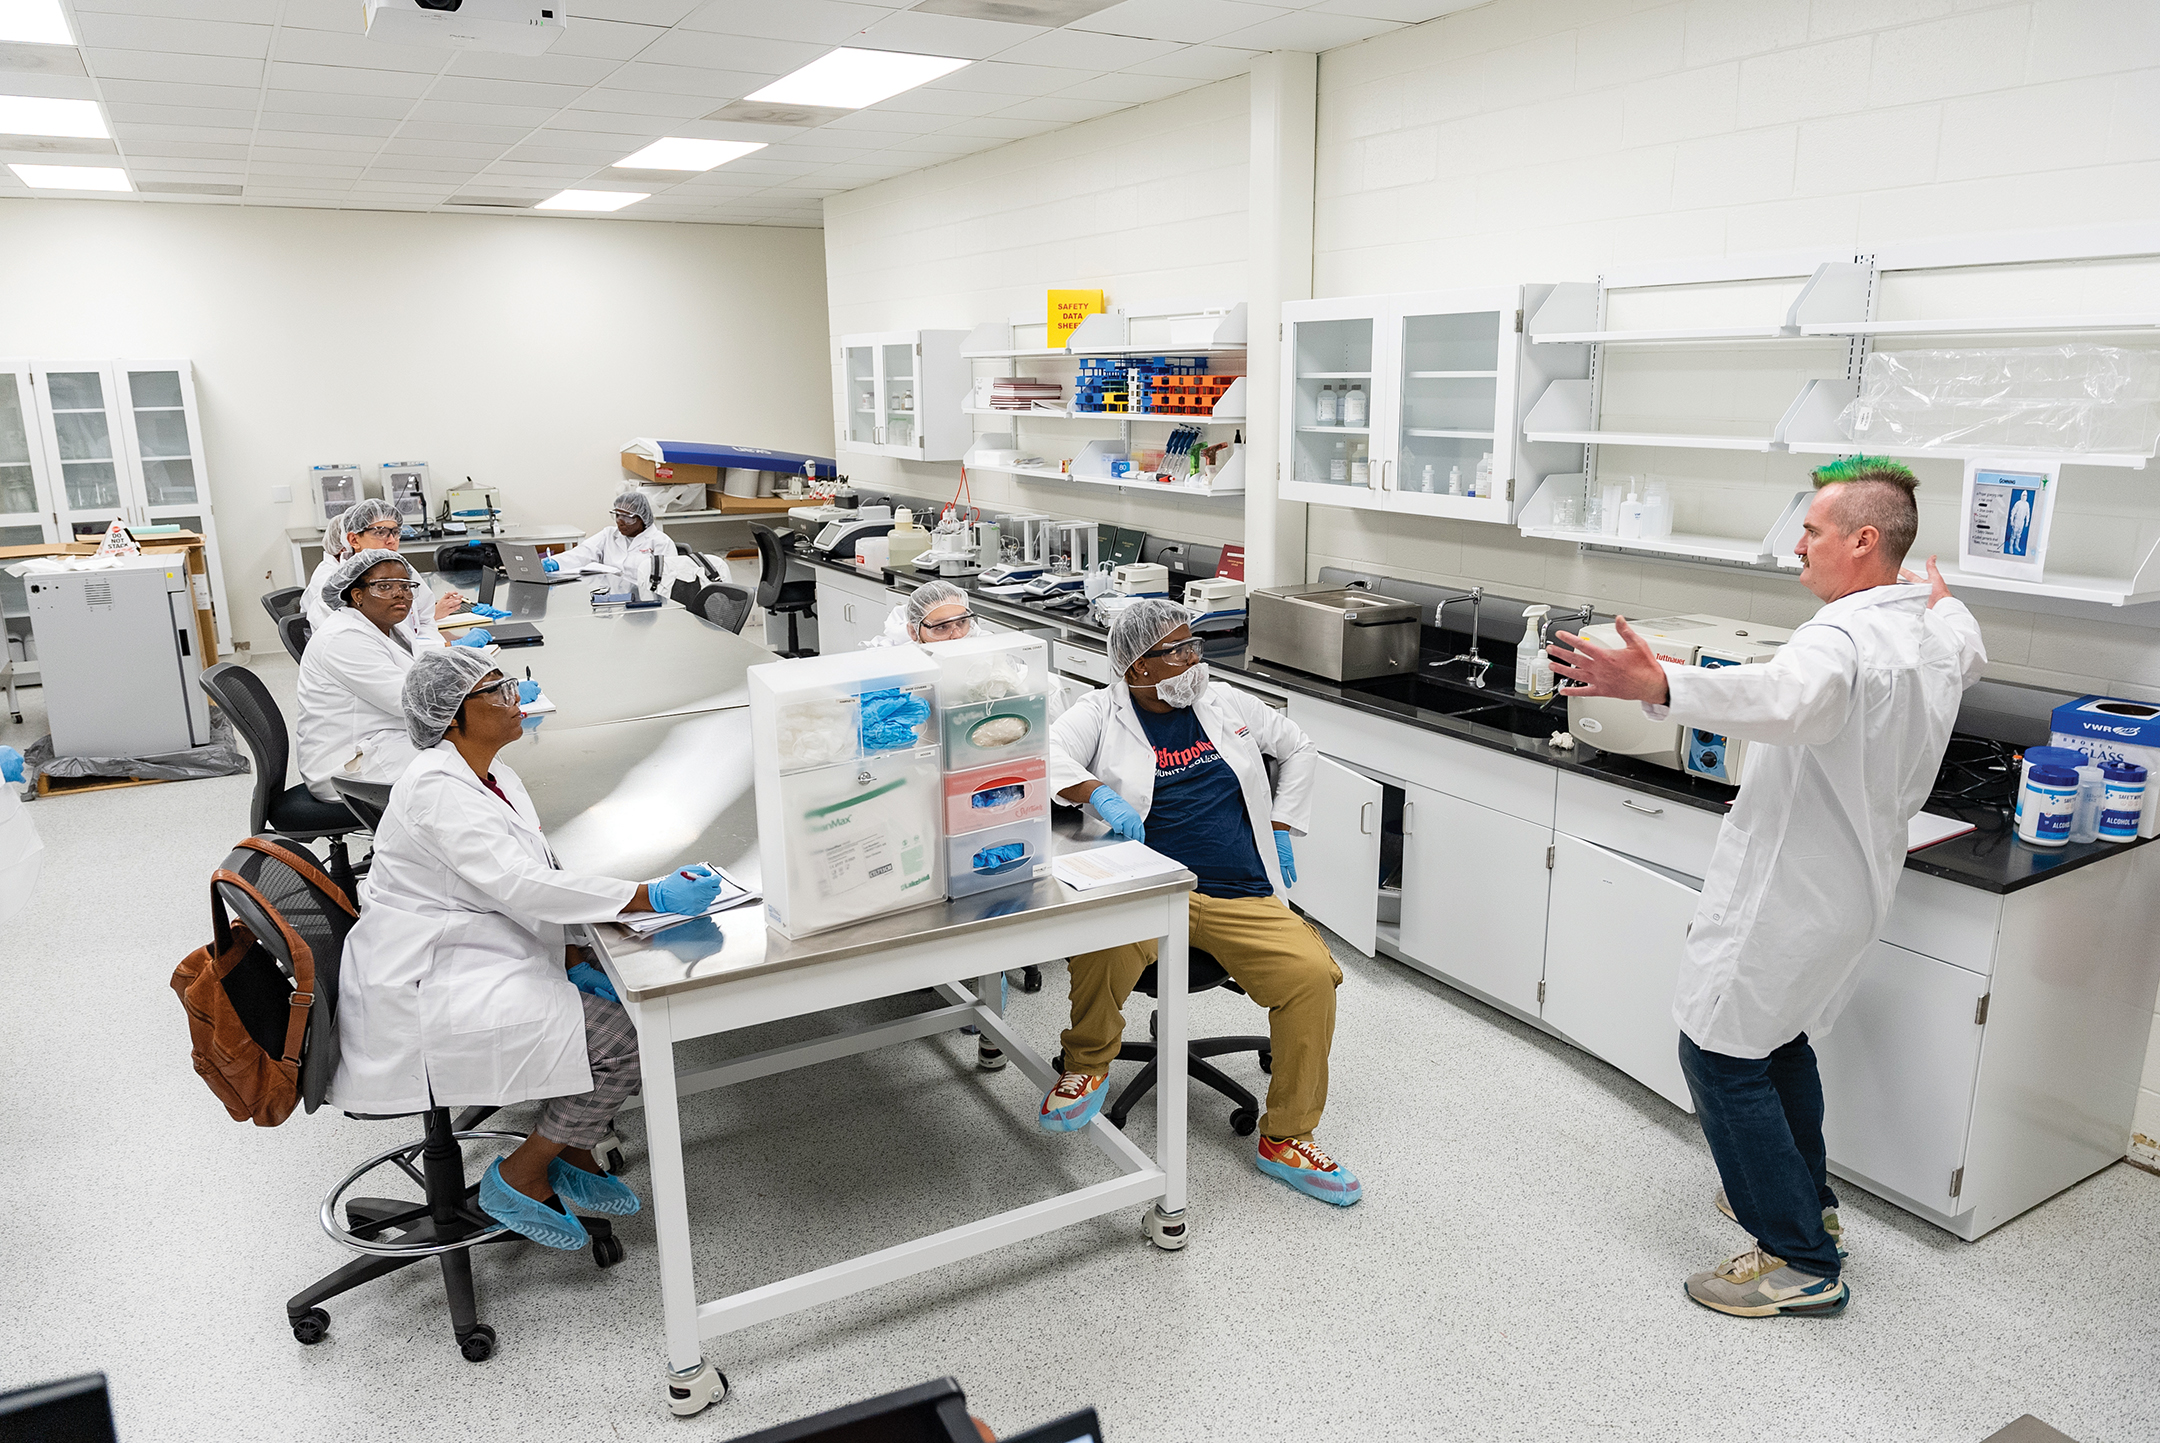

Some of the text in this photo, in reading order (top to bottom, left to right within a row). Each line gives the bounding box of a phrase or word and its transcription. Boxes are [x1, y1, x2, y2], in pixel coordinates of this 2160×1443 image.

[1656, 652, 1685, 665] Tuttnauer
[2083, 722, 2112, 733] VWR
[2063, 737, 2113, 750] BROKEN
[1152, 740, 1214, 769] ightpoin
[2077, 746, 2124, 763] GLASS
[2106, 816, 2132, 826] ALCOHOL
